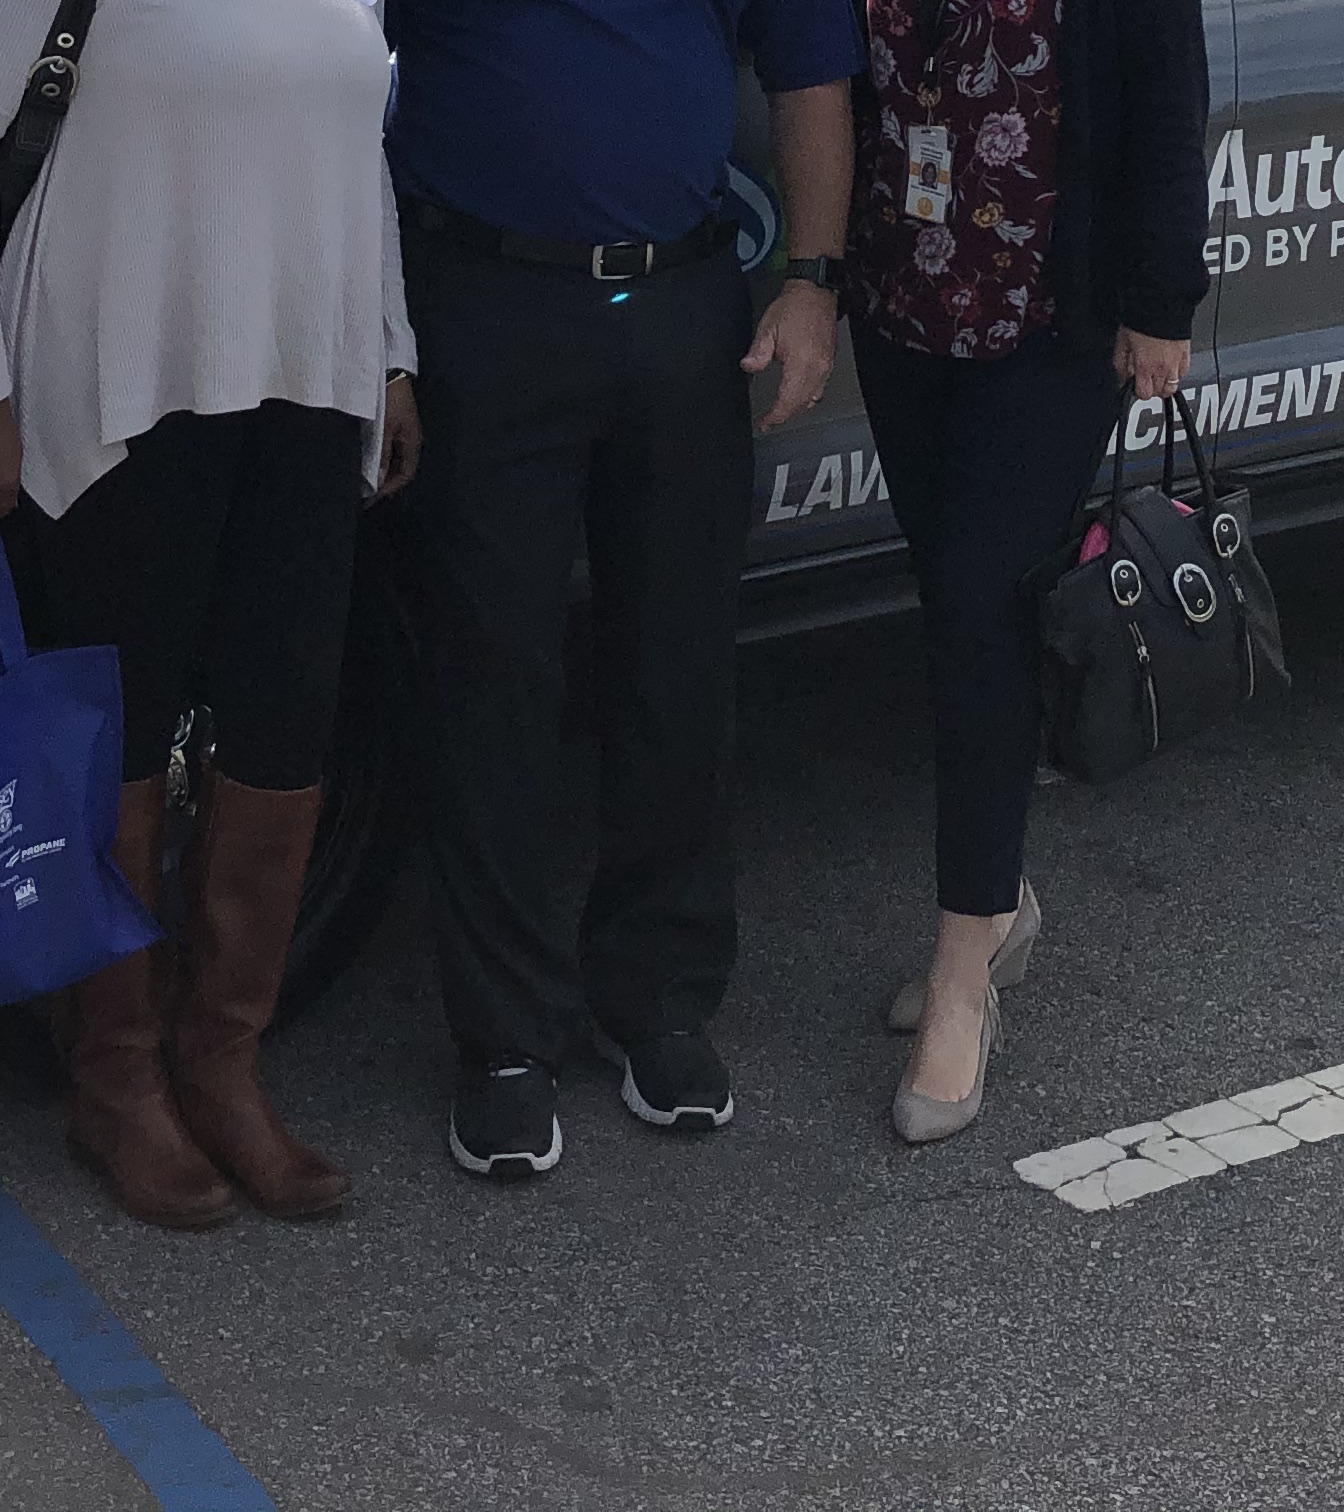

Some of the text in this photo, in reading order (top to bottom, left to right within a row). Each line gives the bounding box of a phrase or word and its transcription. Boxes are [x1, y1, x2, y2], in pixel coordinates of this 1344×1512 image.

[1265, 223, 1318, 267] BY
[765, 449, 890, 523] LAW
[21, 838, 66, 859] PROPANE
